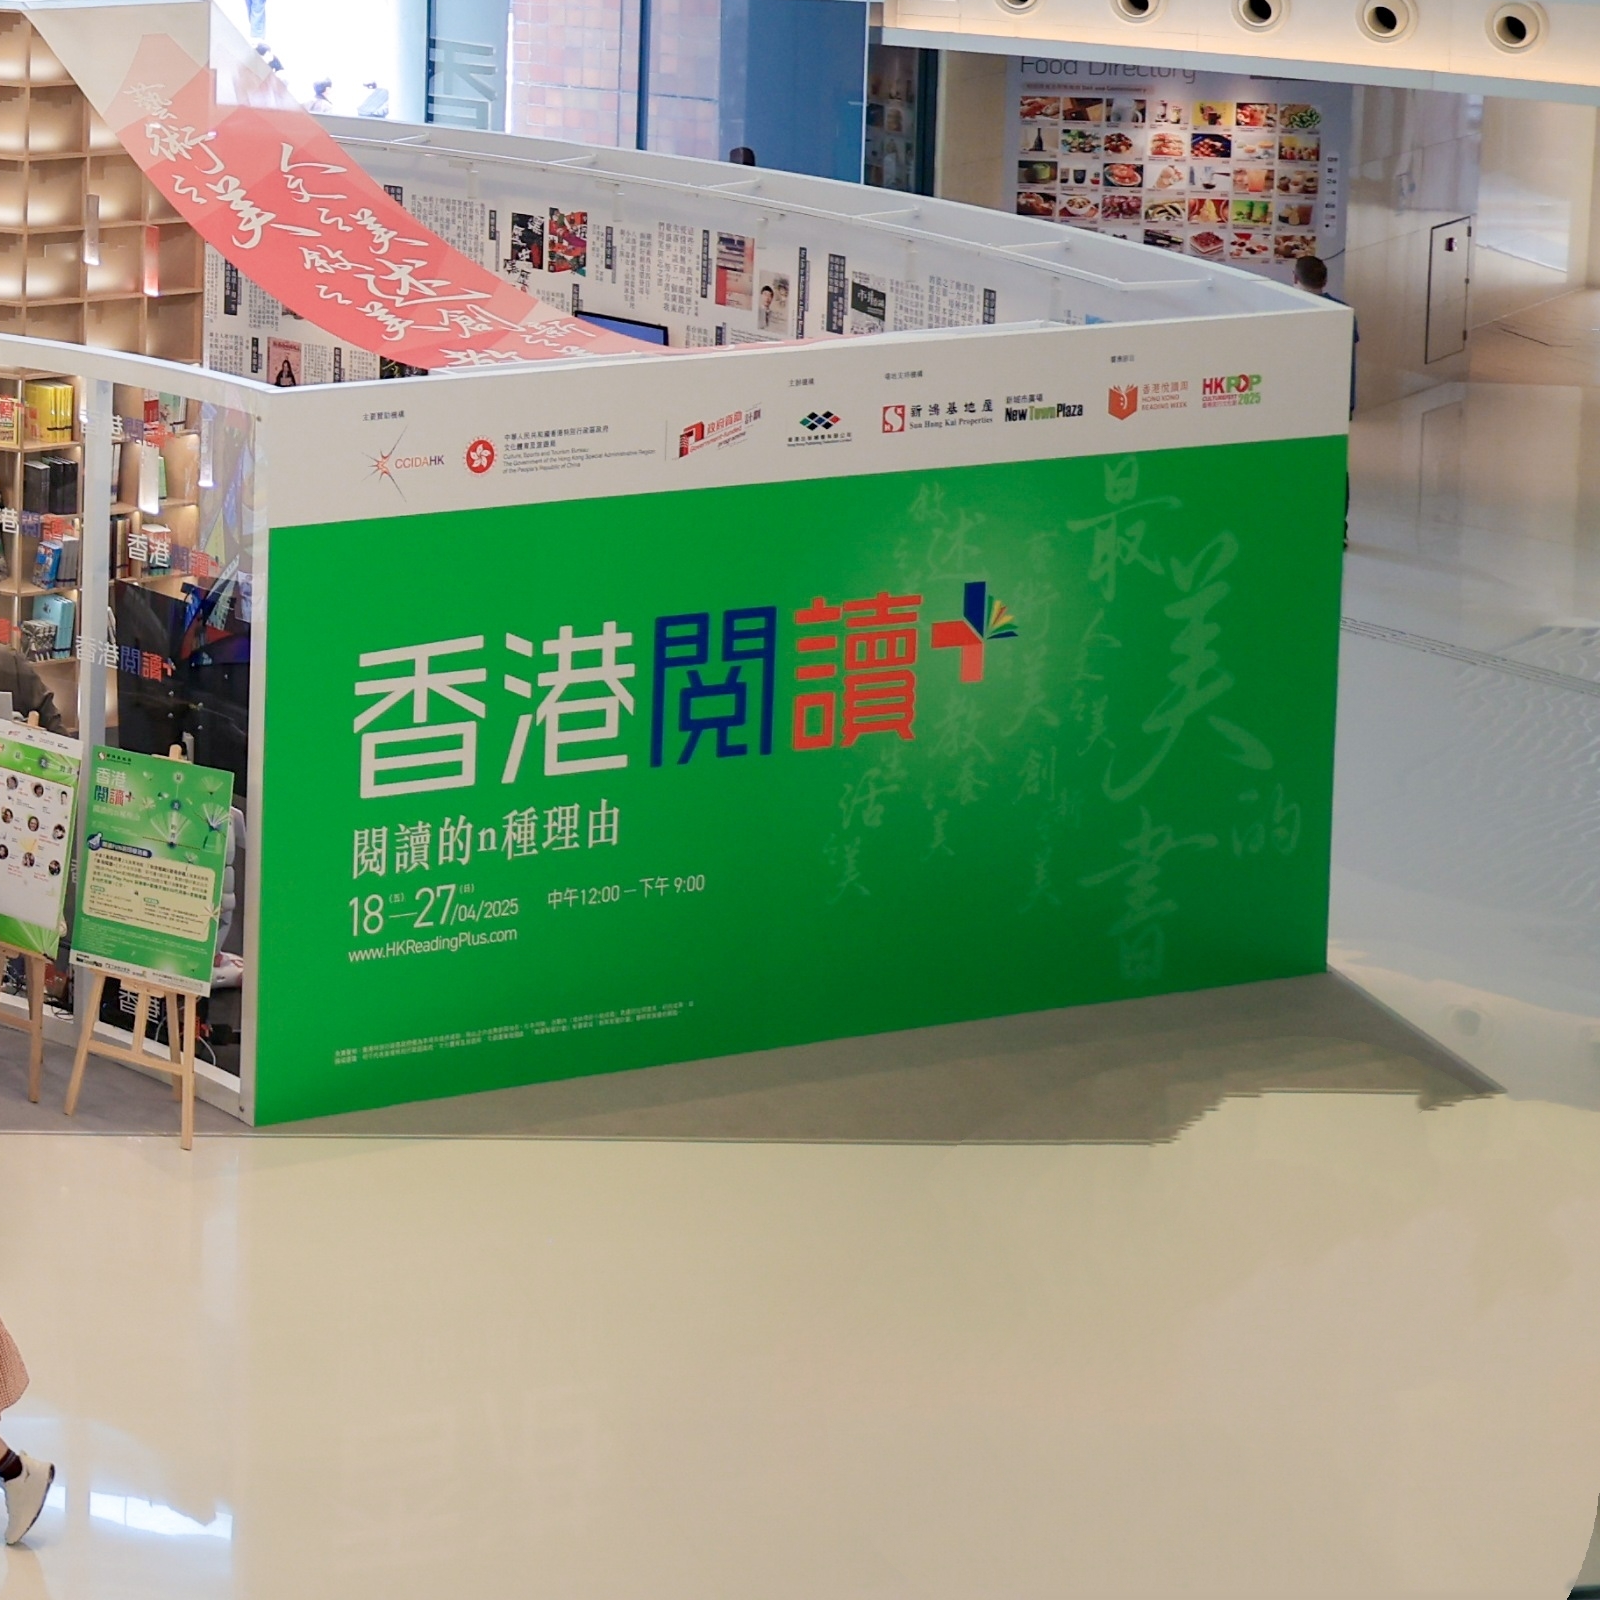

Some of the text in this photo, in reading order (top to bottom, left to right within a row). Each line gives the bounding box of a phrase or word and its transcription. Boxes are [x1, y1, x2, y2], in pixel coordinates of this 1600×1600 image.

[1020, 56, 1078, 76] Food
[910, 398, 995, 419] 新鴻基地產
[1237, 392, 1262, 407] 2025
[909, 416, 994, 430] Sun Hung Kai Properties
[1004, 403, 1084, 423] New Town Plaza
[394, 453, 446, 471] CCIDAHK
[126, 533, 212, 578] 香港閱讀
[74, 635, 164, 684] 香港閱讀
[352, 591, 923, 800] 香港閱讀
[95, 766, 127, 789] 香港
[93, 785, 126, 807] 閱讀
[351, 797, 622, 880] 閱讀的n種理由
[547, 873, 707, 911] 中午12:00 下午 9:00
[348, 925, 519, 964] www.HKReadingPlus.com
